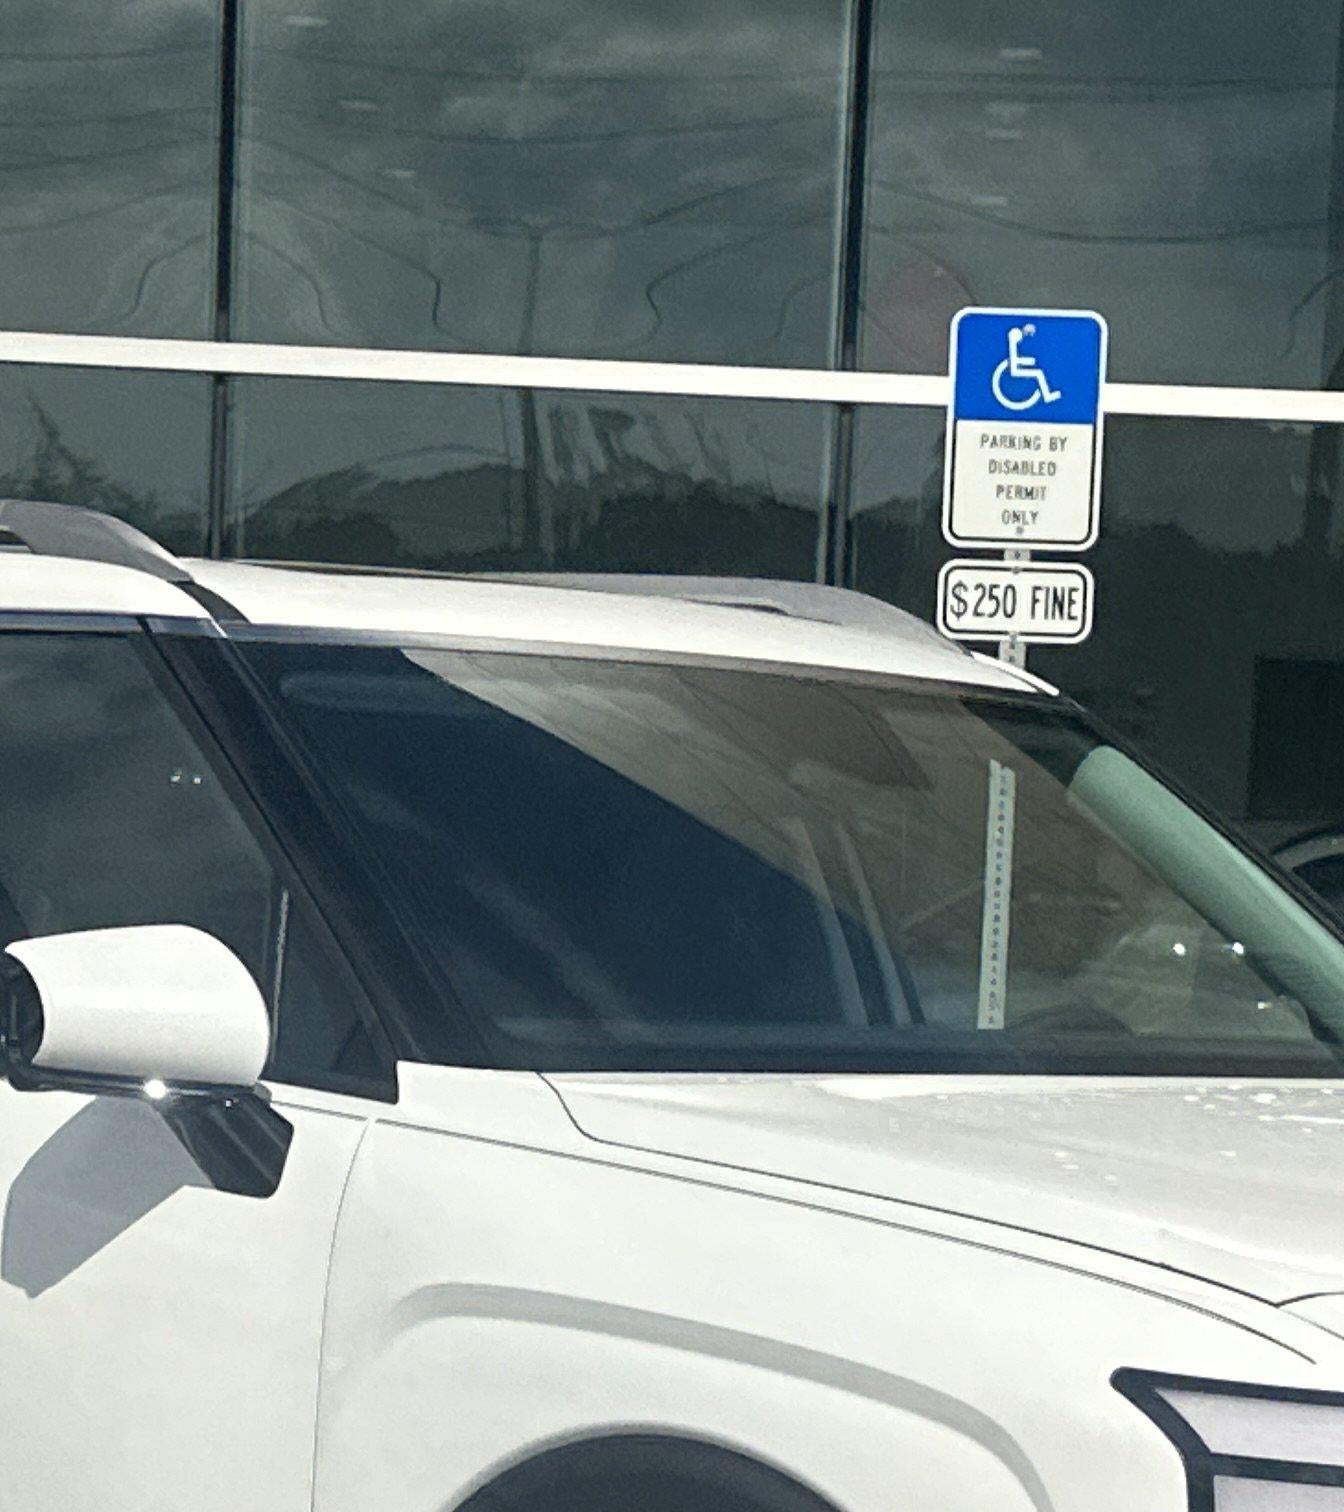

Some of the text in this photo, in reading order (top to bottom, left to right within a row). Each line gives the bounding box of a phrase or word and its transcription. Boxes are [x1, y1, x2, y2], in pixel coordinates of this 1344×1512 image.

[979, 433, 1068, 452] PARKING BY
[988, 458, 1057, 476] DISABLED
[996, 484, 1047, 500] PERMIT
[1001, 510, 1040, 526] ONLY
[949, 580, 1080, 621] $250 FINE
